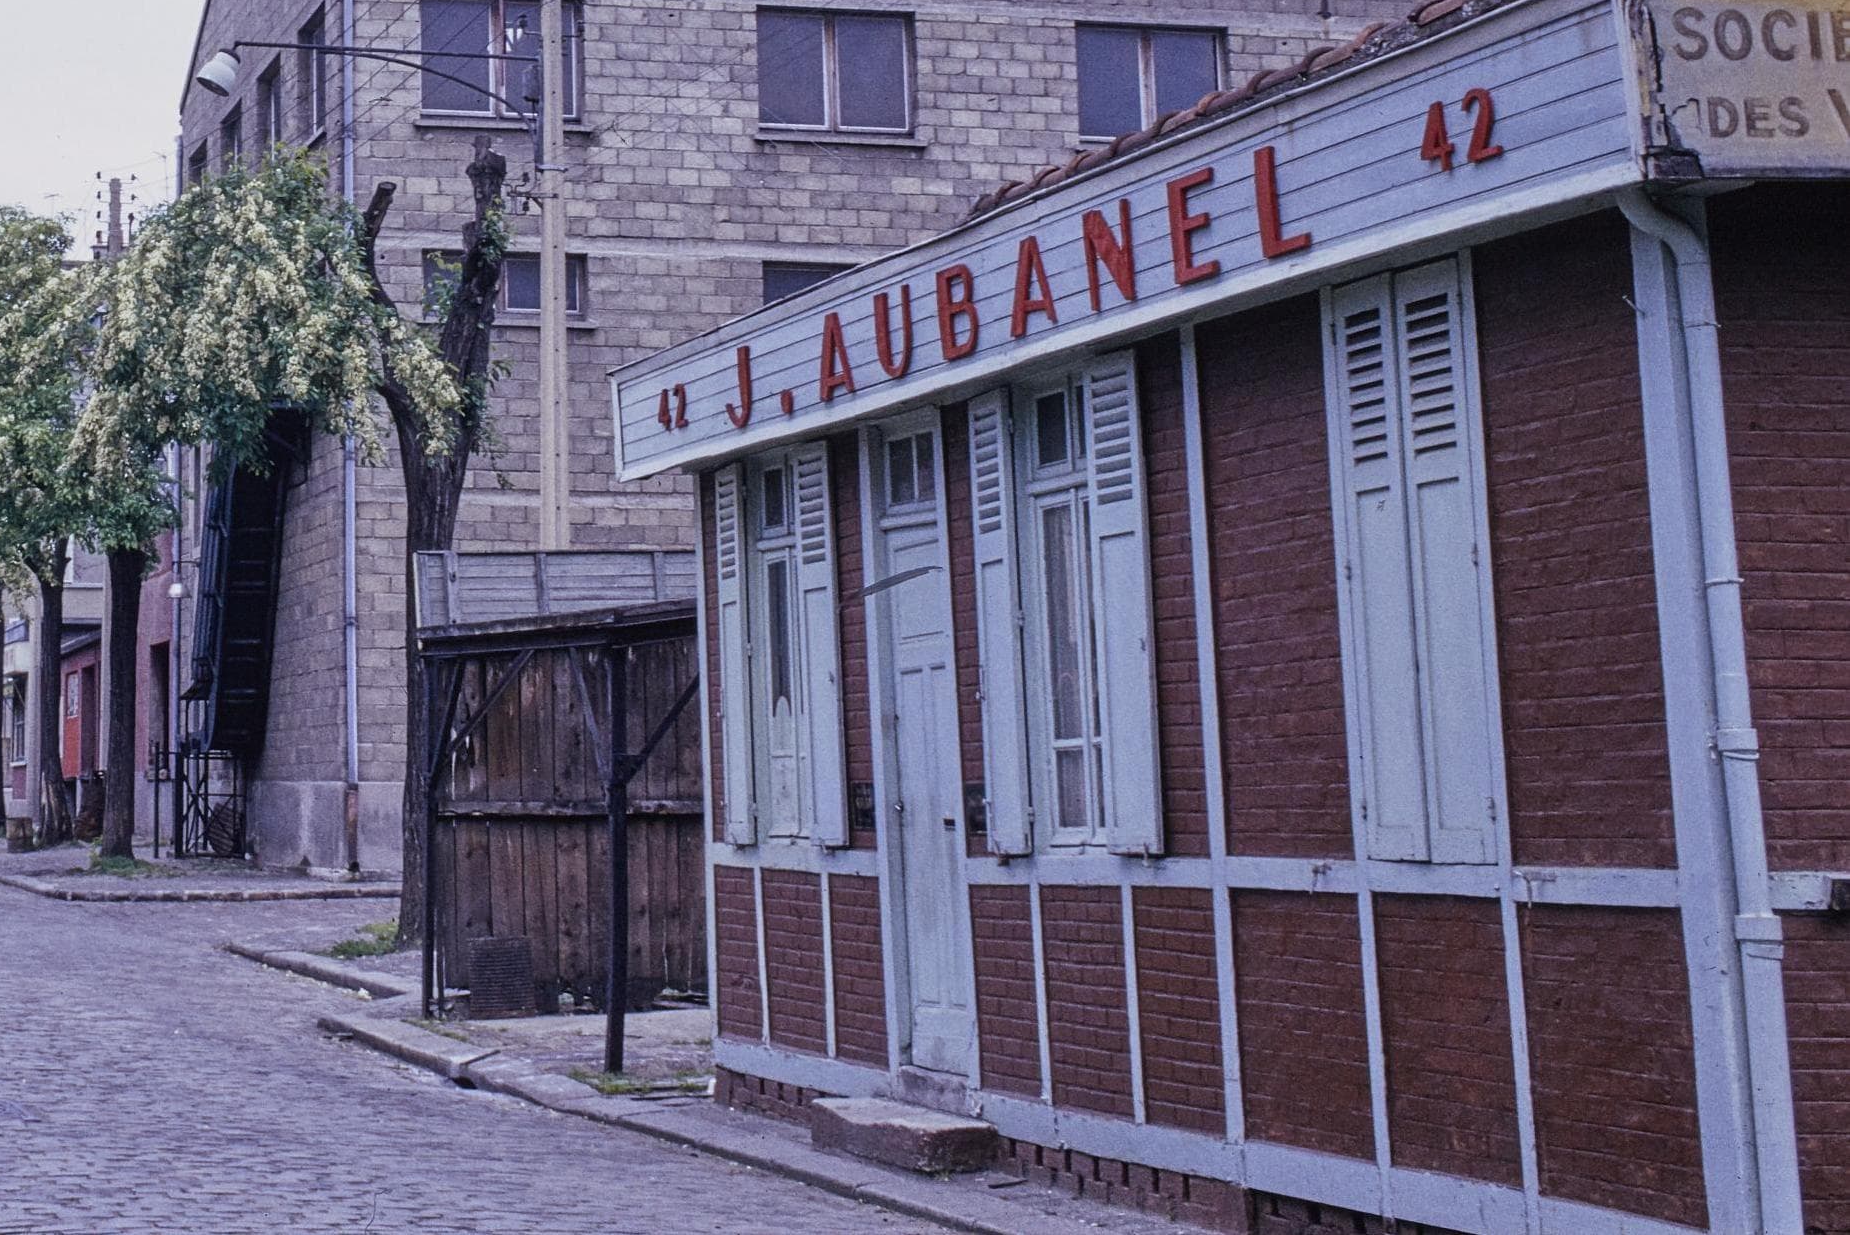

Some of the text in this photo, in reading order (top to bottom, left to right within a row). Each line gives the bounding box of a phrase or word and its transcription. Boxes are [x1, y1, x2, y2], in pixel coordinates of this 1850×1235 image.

[1706, 95, 1811, 140] DES
[658, 87, 1505, 433] 42 J. AUBANEL 42
